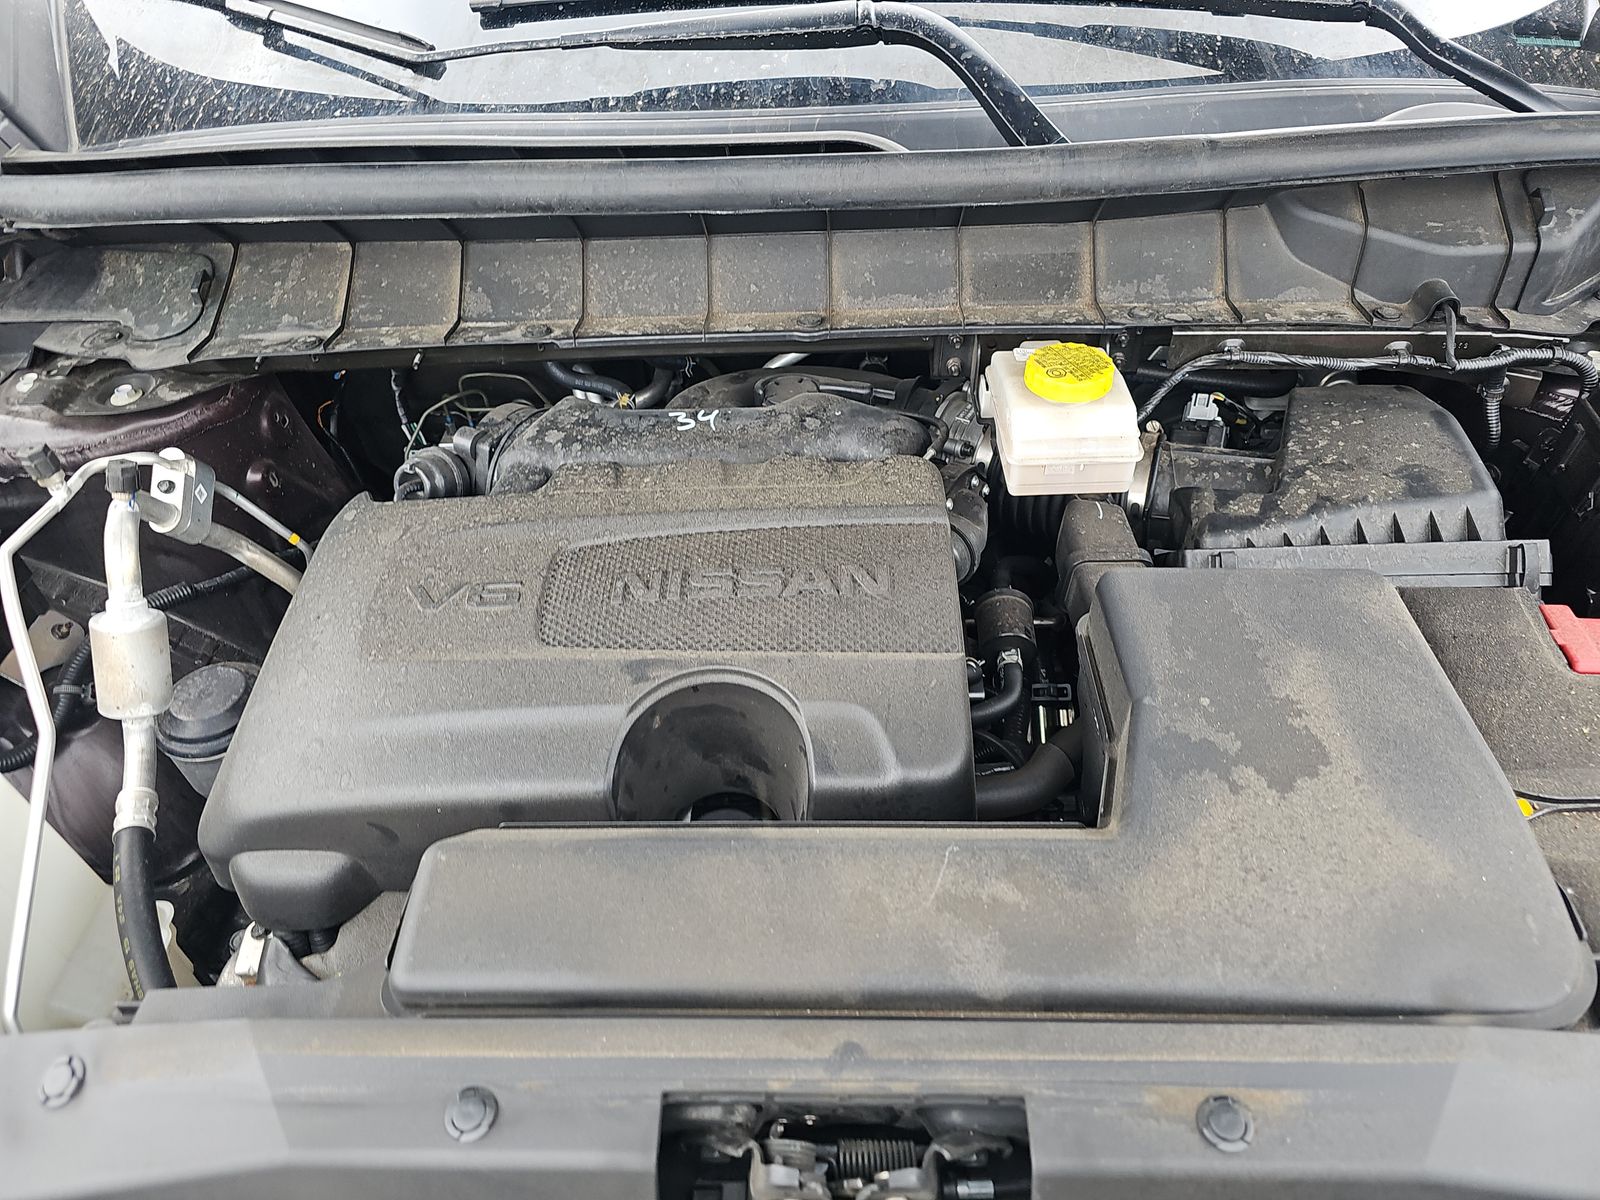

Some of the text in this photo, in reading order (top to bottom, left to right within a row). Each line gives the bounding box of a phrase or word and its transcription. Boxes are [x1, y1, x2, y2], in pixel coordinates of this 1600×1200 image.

[668, 409, 719, 431] 34
[405, 581, 522, 612] V6
[611, 564, 892, 601] NISSAN
